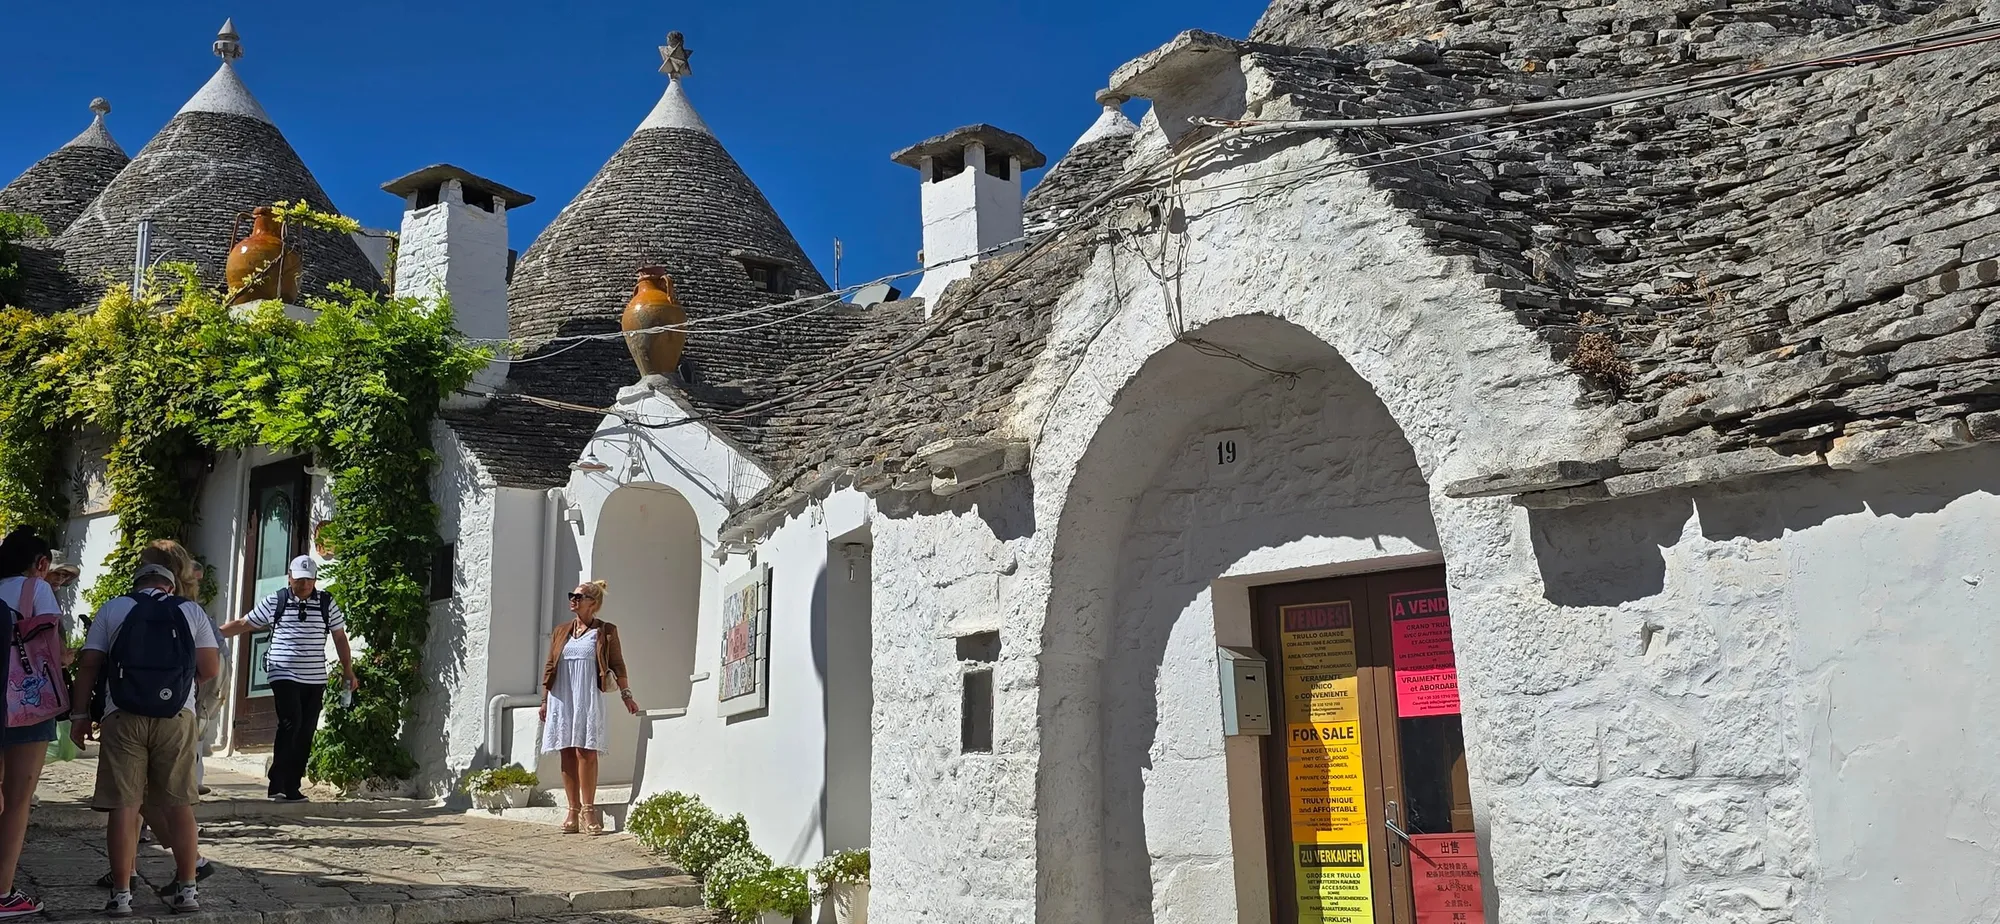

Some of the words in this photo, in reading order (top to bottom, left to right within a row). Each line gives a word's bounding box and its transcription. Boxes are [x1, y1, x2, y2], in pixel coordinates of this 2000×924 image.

[1217, 440, 1236, 465] 19
[1395, 598, 1405, 616] À
[1300, 674, 1342, 682] VERAMENTE
[1401, 675, 1440, 683] VRAIMENT
[1301, 690, 1348, 699] CONVENIENTE
[1293, 729, 1318, 741] FOR
[1322, 727, 1354, 740] SALE
[1440, 841, 1459, 854] 出售
[1301, 850, 1313, 863] ZU
[1314, 850, 1362, 863] VERKAUFEN
